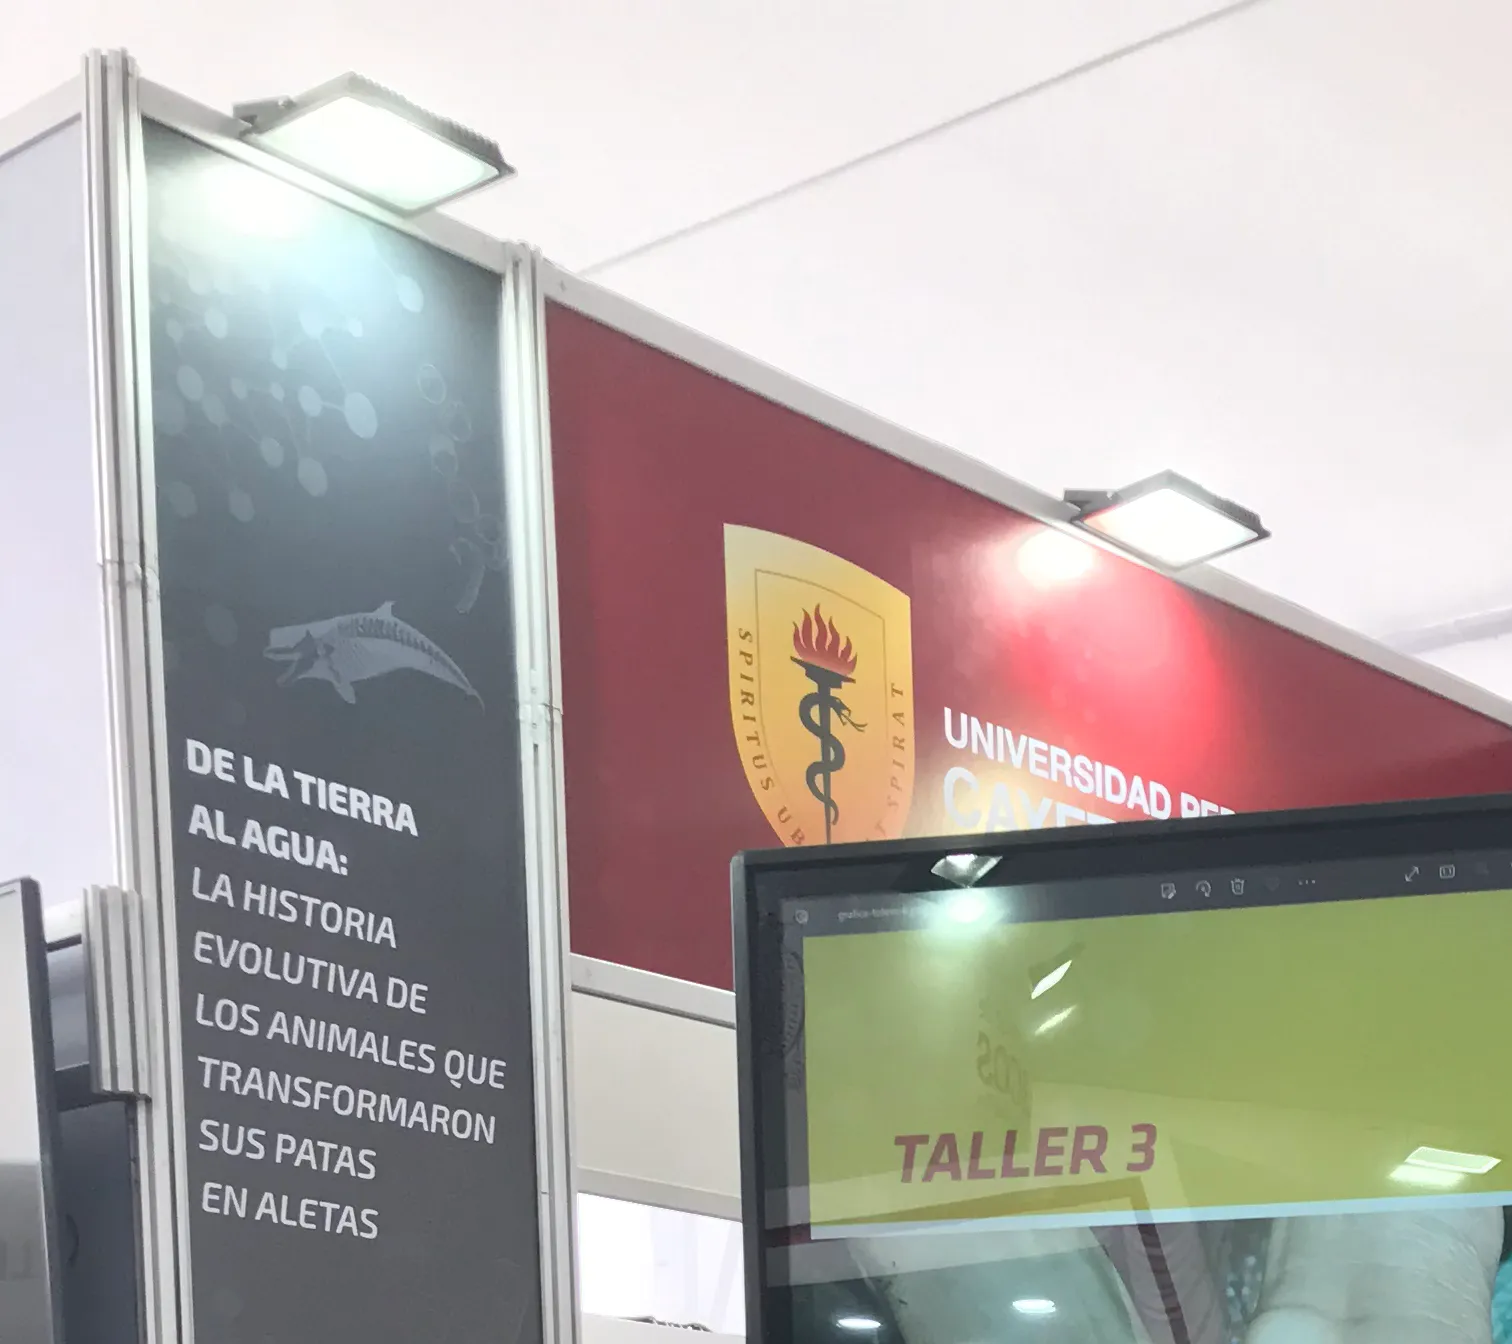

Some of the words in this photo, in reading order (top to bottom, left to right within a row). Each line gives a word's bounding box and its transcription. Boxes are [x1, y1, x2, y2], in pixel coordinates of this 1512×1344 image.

[738, 627, 776, 792] SPIRITUS
[186, 739, 235, 784] DE
[242, 754, 290, 801] LA
[293, 770, 418, 837] TIERRA
[944, 706, 1171, 820] UNIVERSIDAD
[187, 804, 237, 848] AL
[241, 817, 348, 876] AGUA:
[191, 866, 235, 908] LA
[243, 878, 398, 949] HISTORIA
[193, 931, 380, 1005] EVOLUTIVA
[387, 978, 428, 1015] DE
[195, 992, 260, 1037] LOS
[267, 1009, 436, 1076] ANIMALES
[445, 1049, 506, 1091] QUE
[197, 1055, 497, 1146] TRANSFORMARON
[198, 1120, 266, 1161] SUS
[275, 1133, 377, 1182] PATAS
[893, 1124, 1109, 1184] TALLER
[1126, 1122, 1158, 1173] 3
[202, 1181, 249, 1220] EN
[255, 1191, 380, 1241] ALETAS
